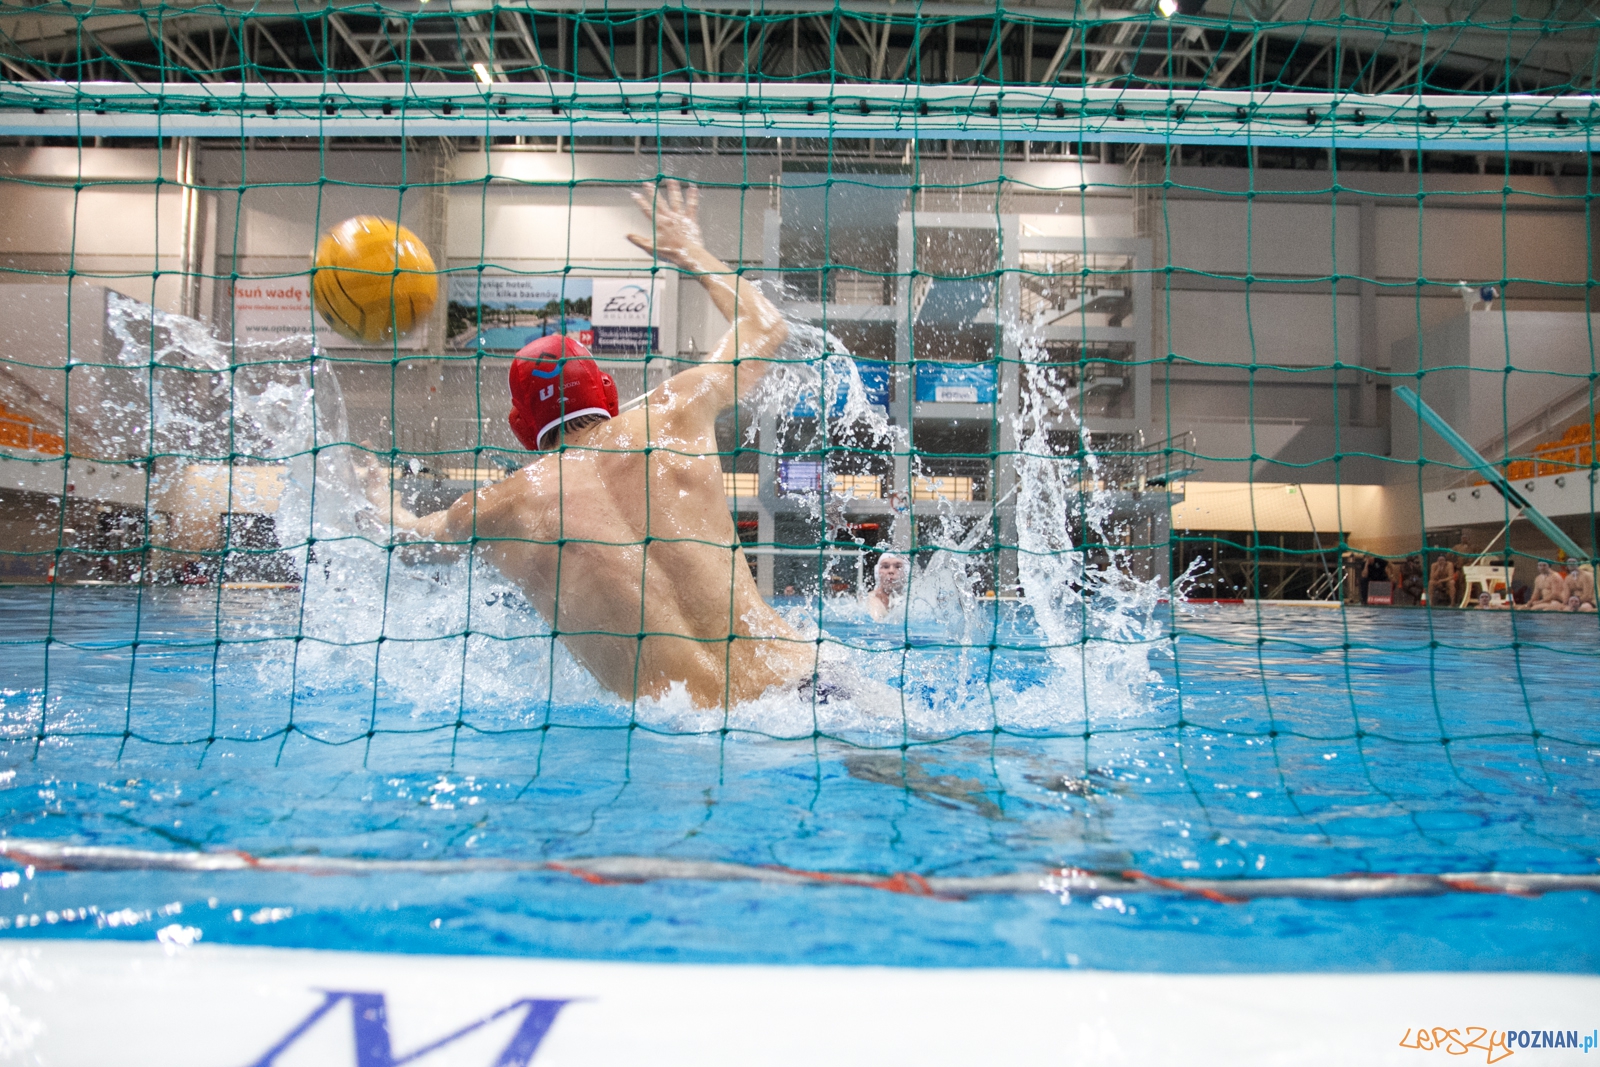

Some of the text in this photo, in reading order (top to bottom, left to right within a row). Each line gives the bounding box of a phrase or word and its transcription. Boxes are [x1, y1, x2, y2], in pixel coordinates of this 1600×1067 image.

[266, 287, 302, 301] wadę
[496, 290, 517, 298] kilka
[520, 290, 558, 298] basenów
[603, 296, 646, 312] Ecco
